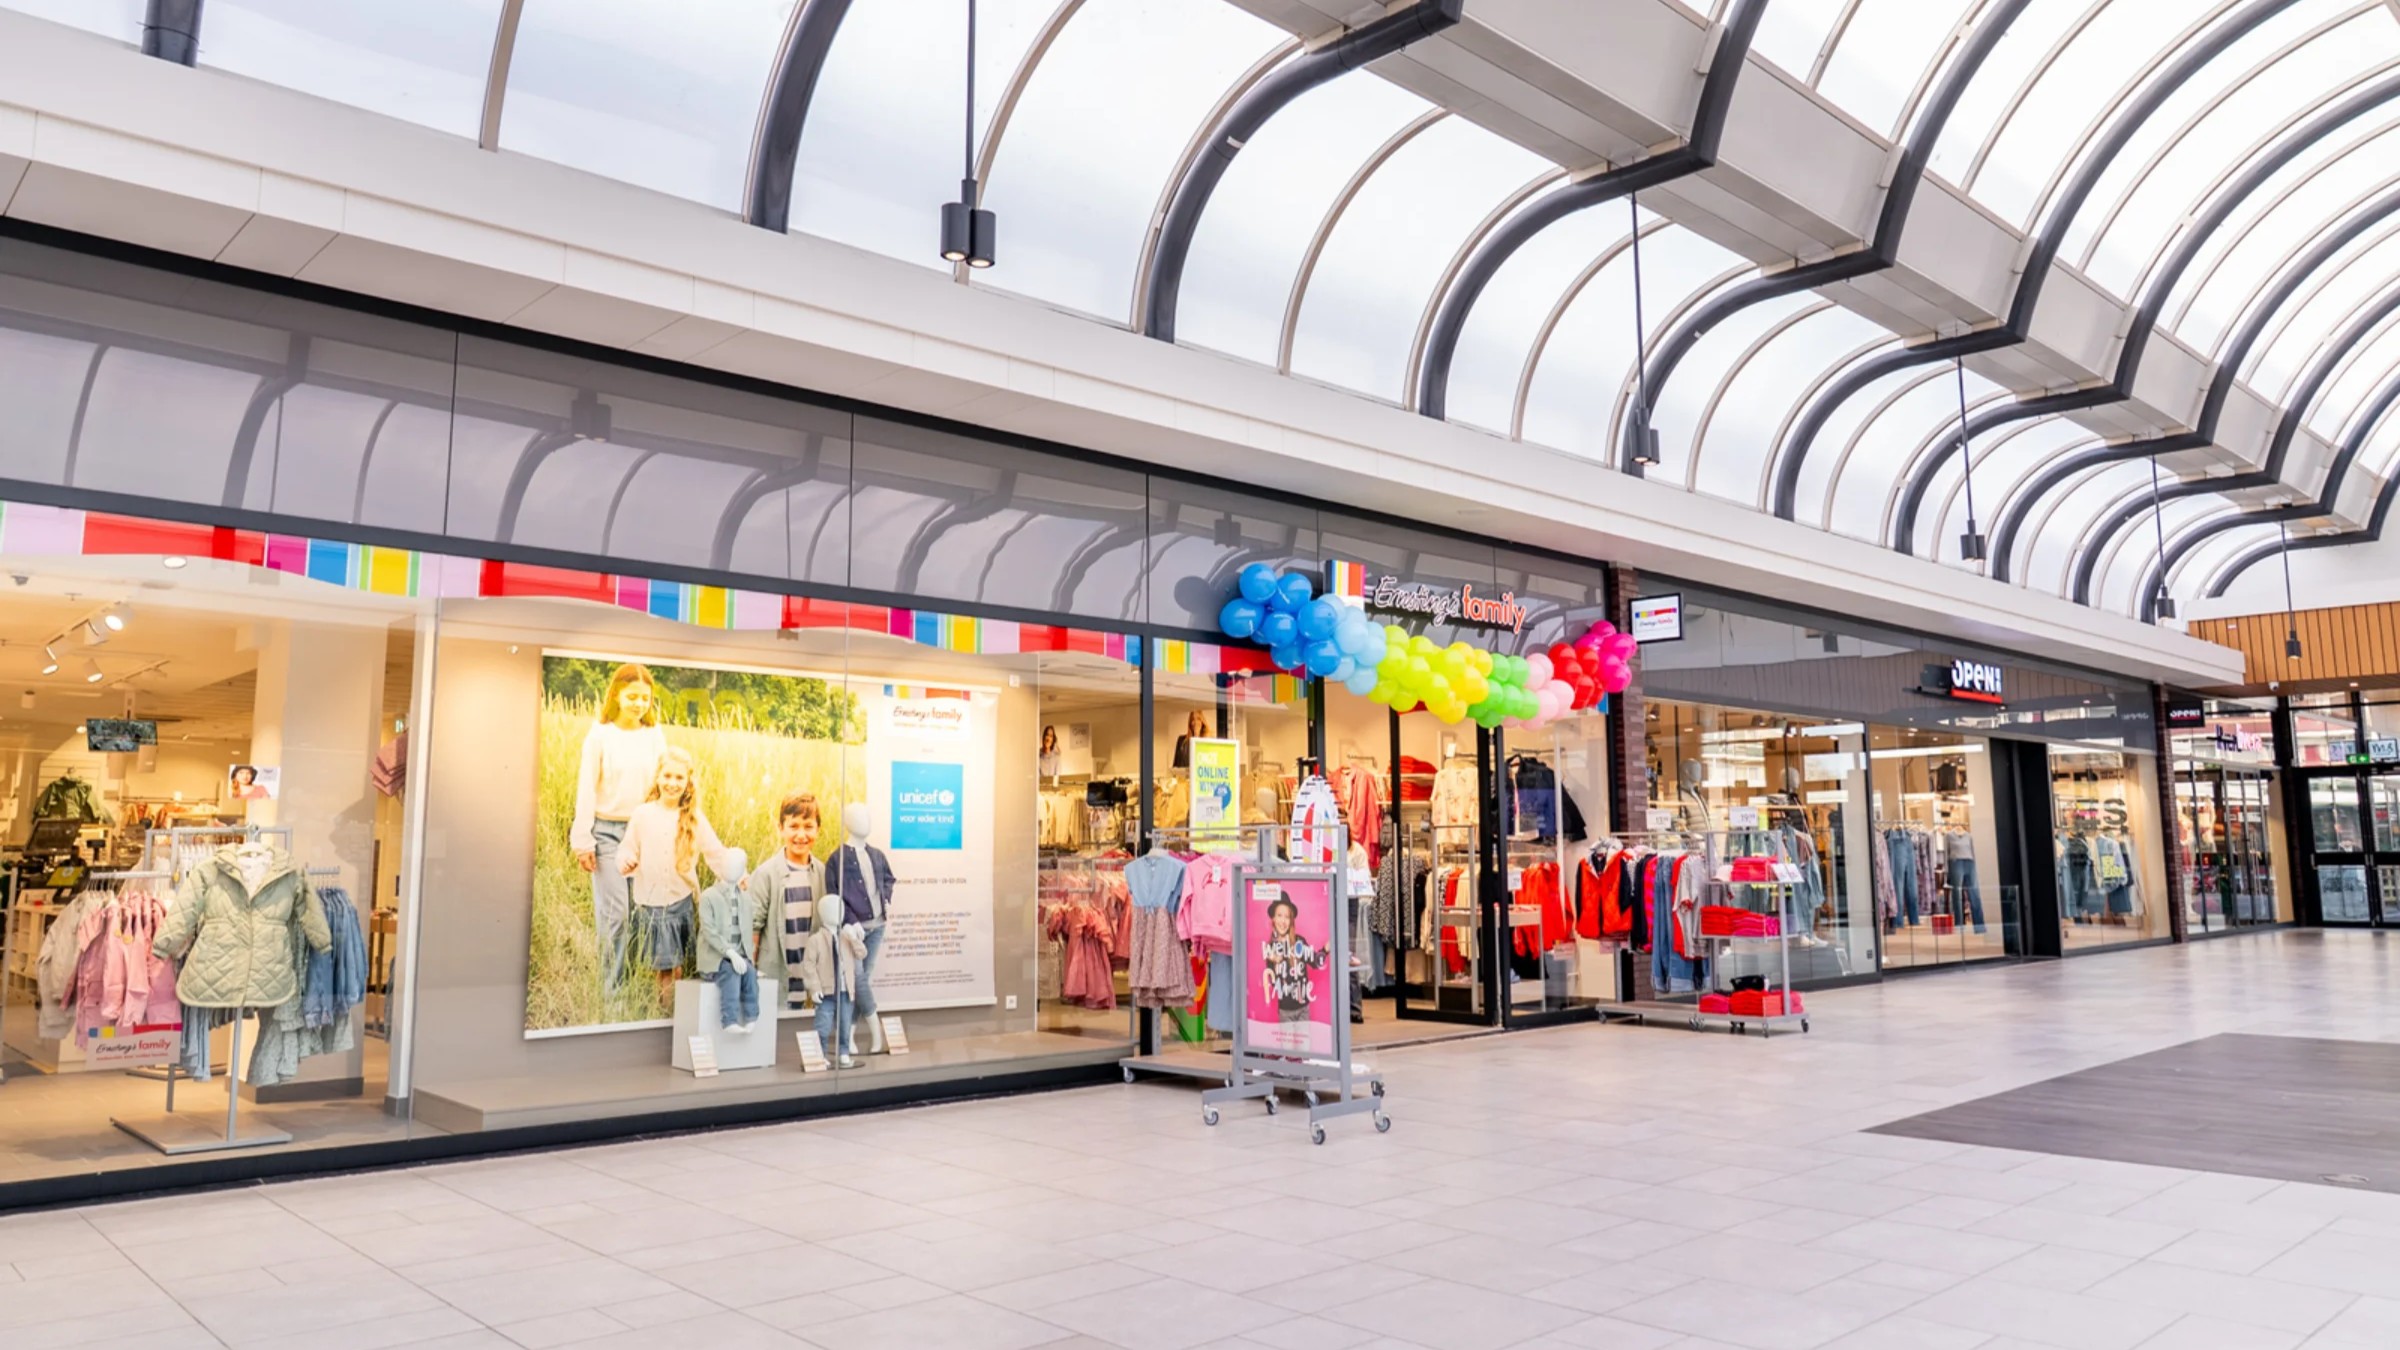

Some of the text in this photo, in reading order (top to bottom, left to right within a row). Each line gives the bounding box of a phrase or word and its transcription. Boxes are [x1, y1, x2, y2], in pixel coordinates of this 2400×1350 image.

[1462, 584, 1527, 634] family
[931, 707, 962, 721] family
[1197, 766, 1229, 779] ONLINE
[899, 788, 939, 804] unicef
[1275, 959, 1305, 980] in de
[138, 1038, 171, 1050] family
